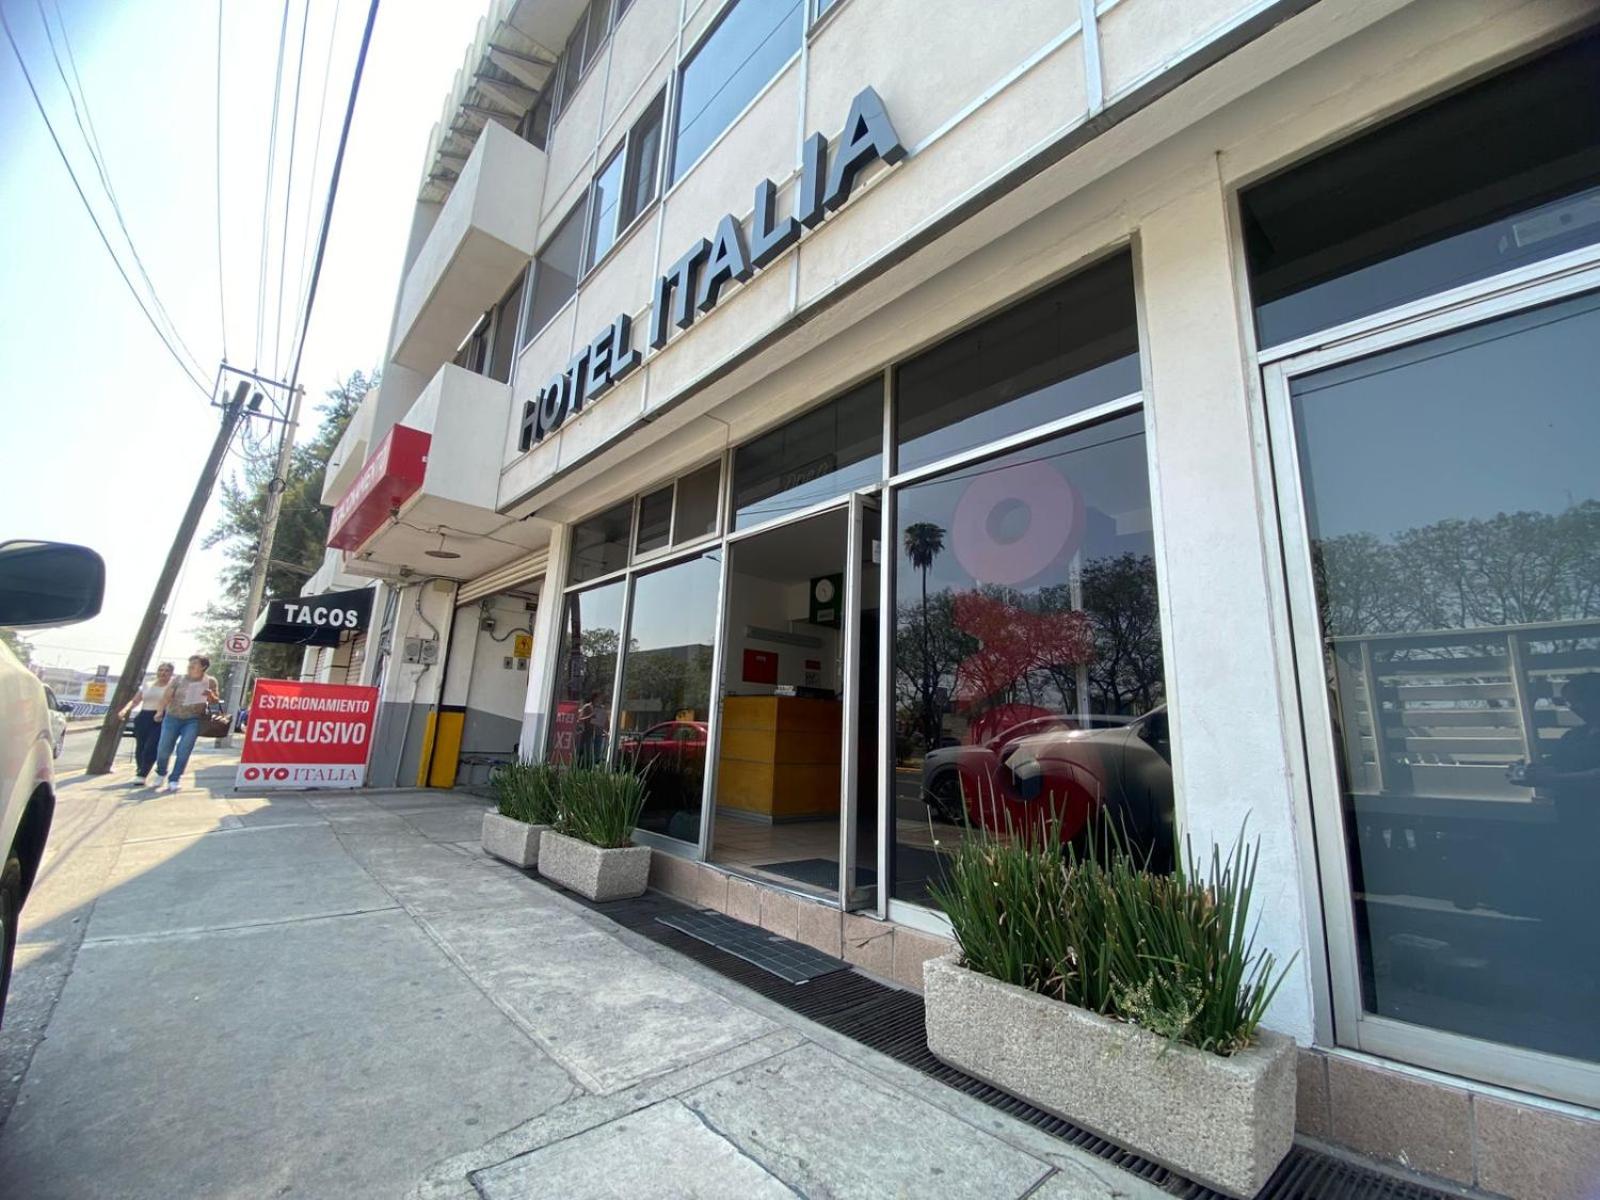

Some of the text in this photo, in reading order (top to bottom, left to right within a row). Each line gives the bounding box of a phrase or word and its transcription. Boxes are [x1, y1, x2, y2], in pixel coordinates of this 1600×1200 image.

[517, 84, 908, 452] HOTEL ITALIA
[284, 603, 358, 628] TACOS
[259, 694, 370, 713] ESTACIONAMIENTO
[251, 718, 367, 745] EXCLUSIVO
[244, 767, 357, 781] OYO ITALIA
